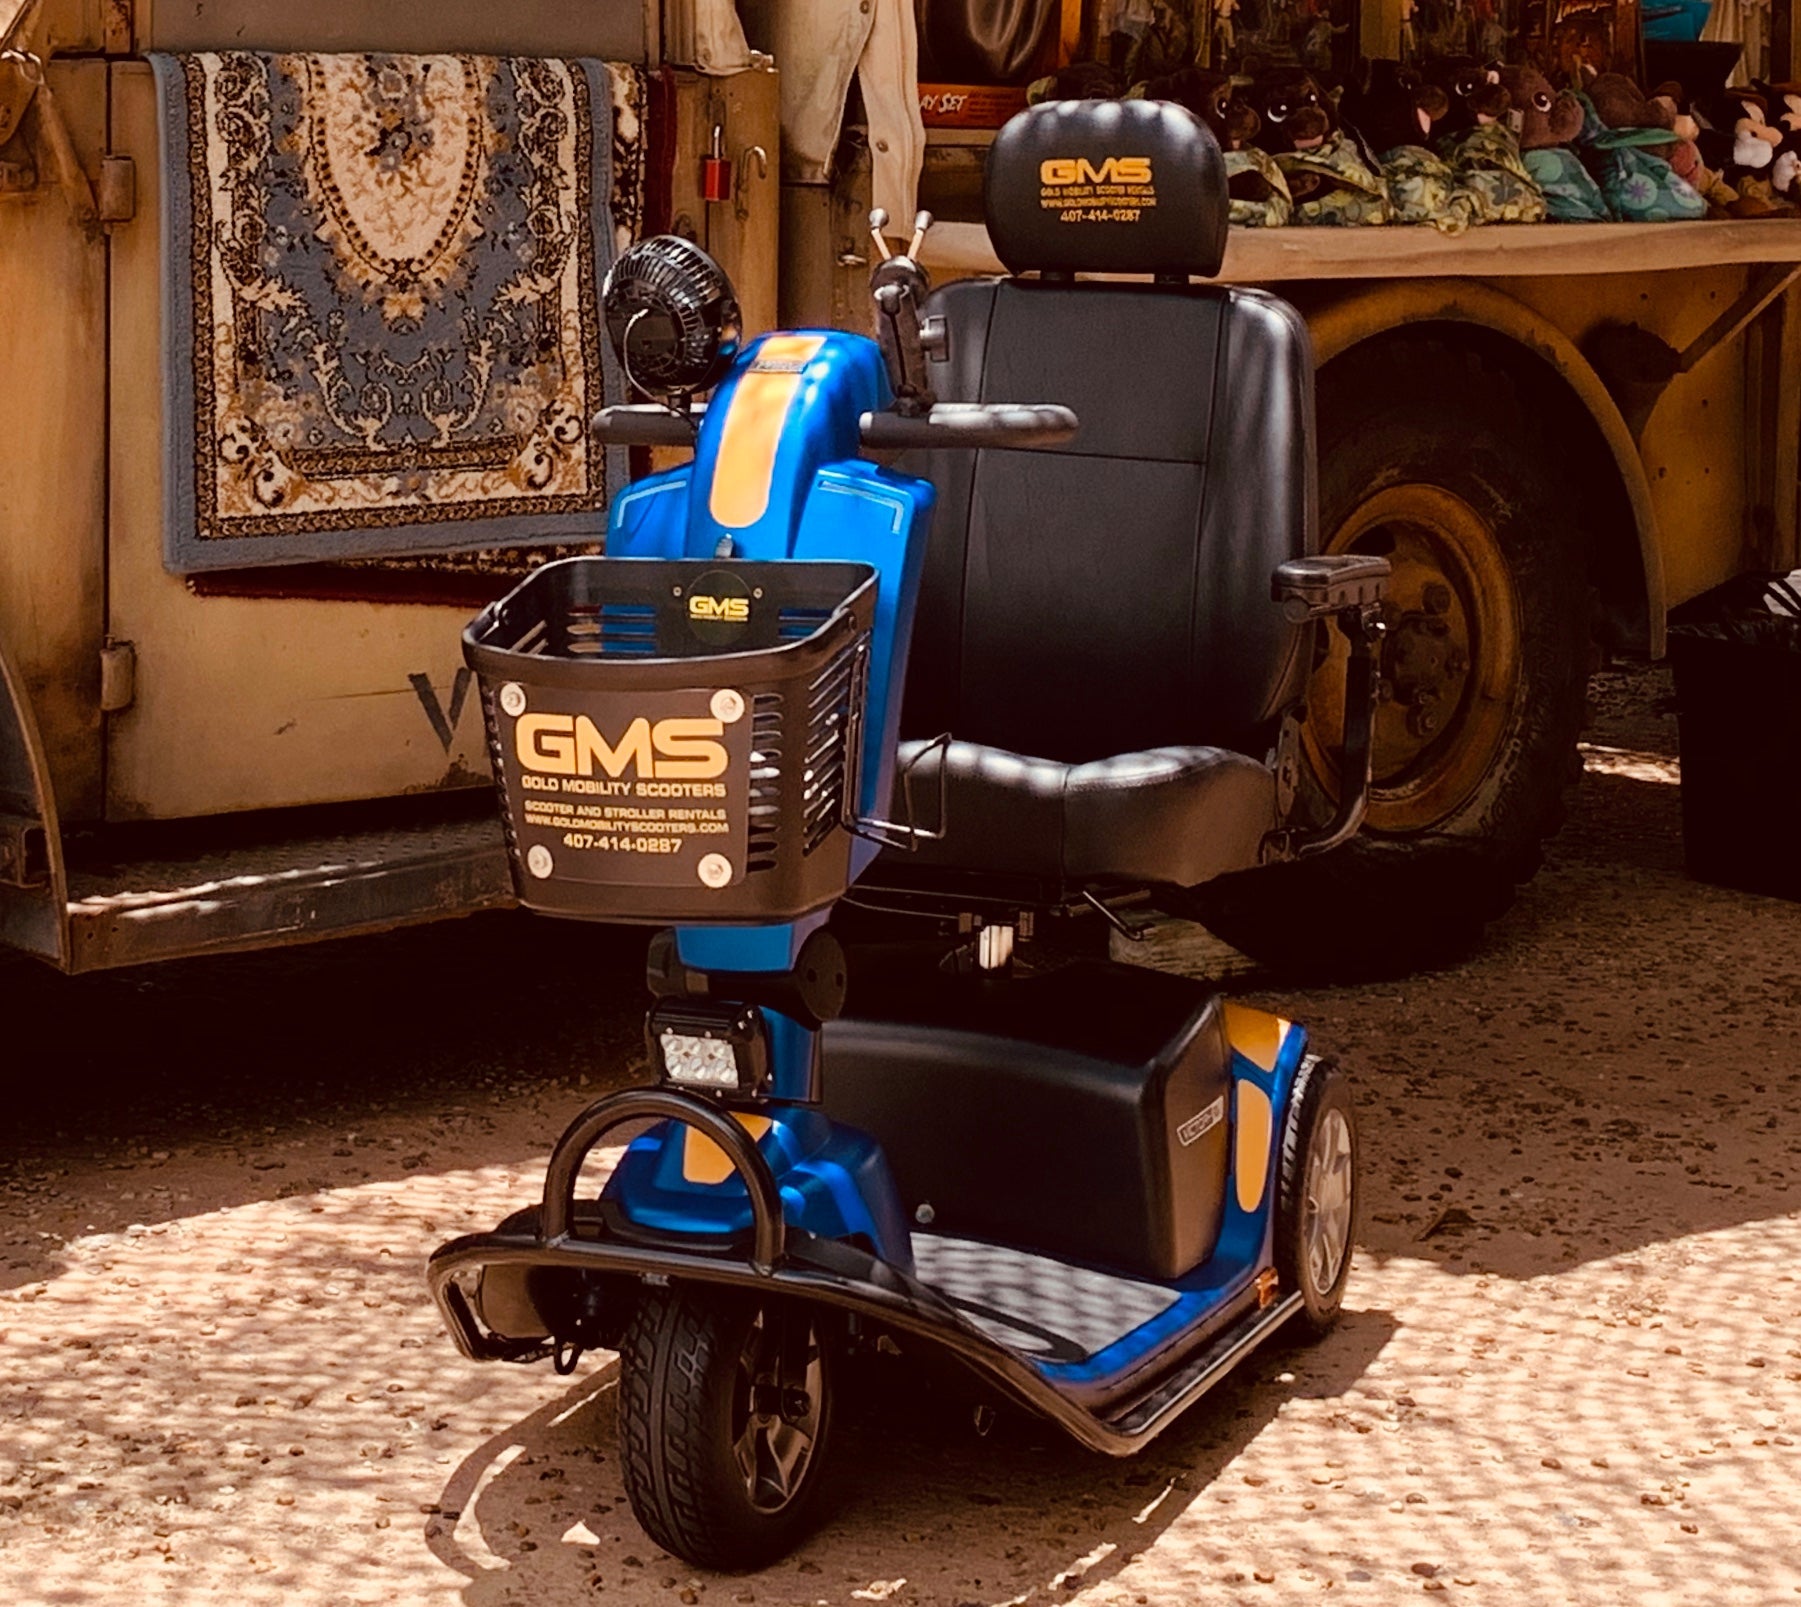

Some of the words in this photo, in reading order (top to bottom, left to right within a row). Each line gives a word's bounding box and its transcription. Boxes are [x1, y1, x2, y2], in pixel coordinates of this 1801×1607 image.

[919, 94, 939, 111] AY
[1040, 157, 1152, 185] GMS
[1060, 209, 1141, 222] 407-414-0287
[689, 595, 750, 617] GMS
[515, 713, 729, 779] GMS
[521, 775, 558, 791] GOLD
[562, 779, 630, 796] MOBILITY
[636, 783, 726, 797] SCOOTERS
[524, 800, 574, 815] SCOOTER
[576, 805, 601, 818] AND
[603, 806, 667, 820] STROLLER
[668, 808, 727, 821] RENTALS
